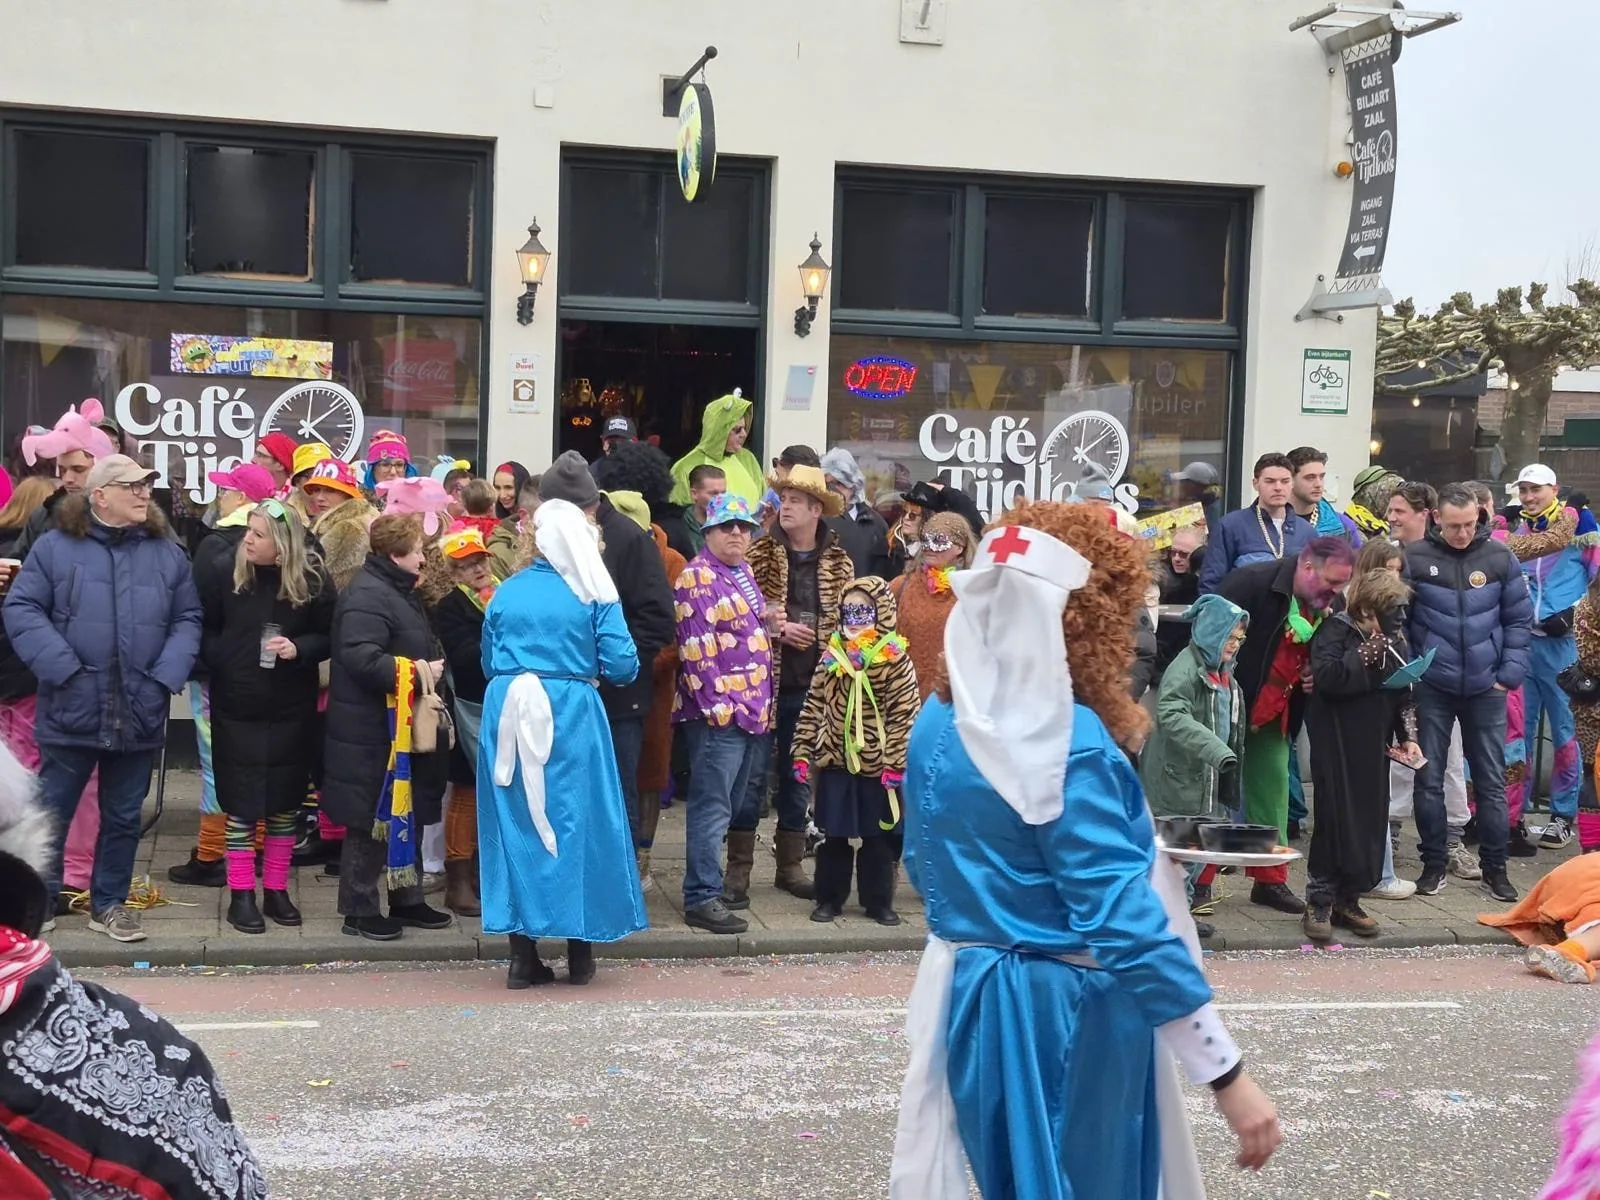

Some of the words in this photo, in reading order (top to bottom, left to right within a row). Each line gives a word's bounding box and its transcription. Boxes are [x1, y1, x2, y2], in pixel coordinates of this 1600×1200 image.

[1361, 69, 1383, 90] CAFÉ
[1356, 88, 1390, 110] BILJART
[1364, 113, 1386, 128] ZAAL
[1354, 137, 1376, 162] Café
[1357, 156, 1395, 184] Tijdloos
[1360, 196, 1383, 211] INGANG
[1361, 213, 1377, 226] ZAAL
[1350, 231, 1360, 244] VIA
[1361, 227, 1383, 242] TERRAS
[515, 361, 534, 370] Duvel
[844, 363, 918, 392] OPEN
[115, 382, 255, 439] Café
[919, 413, 1036, 464] Café
[937, 460, 1139, 521] Tijdlos
